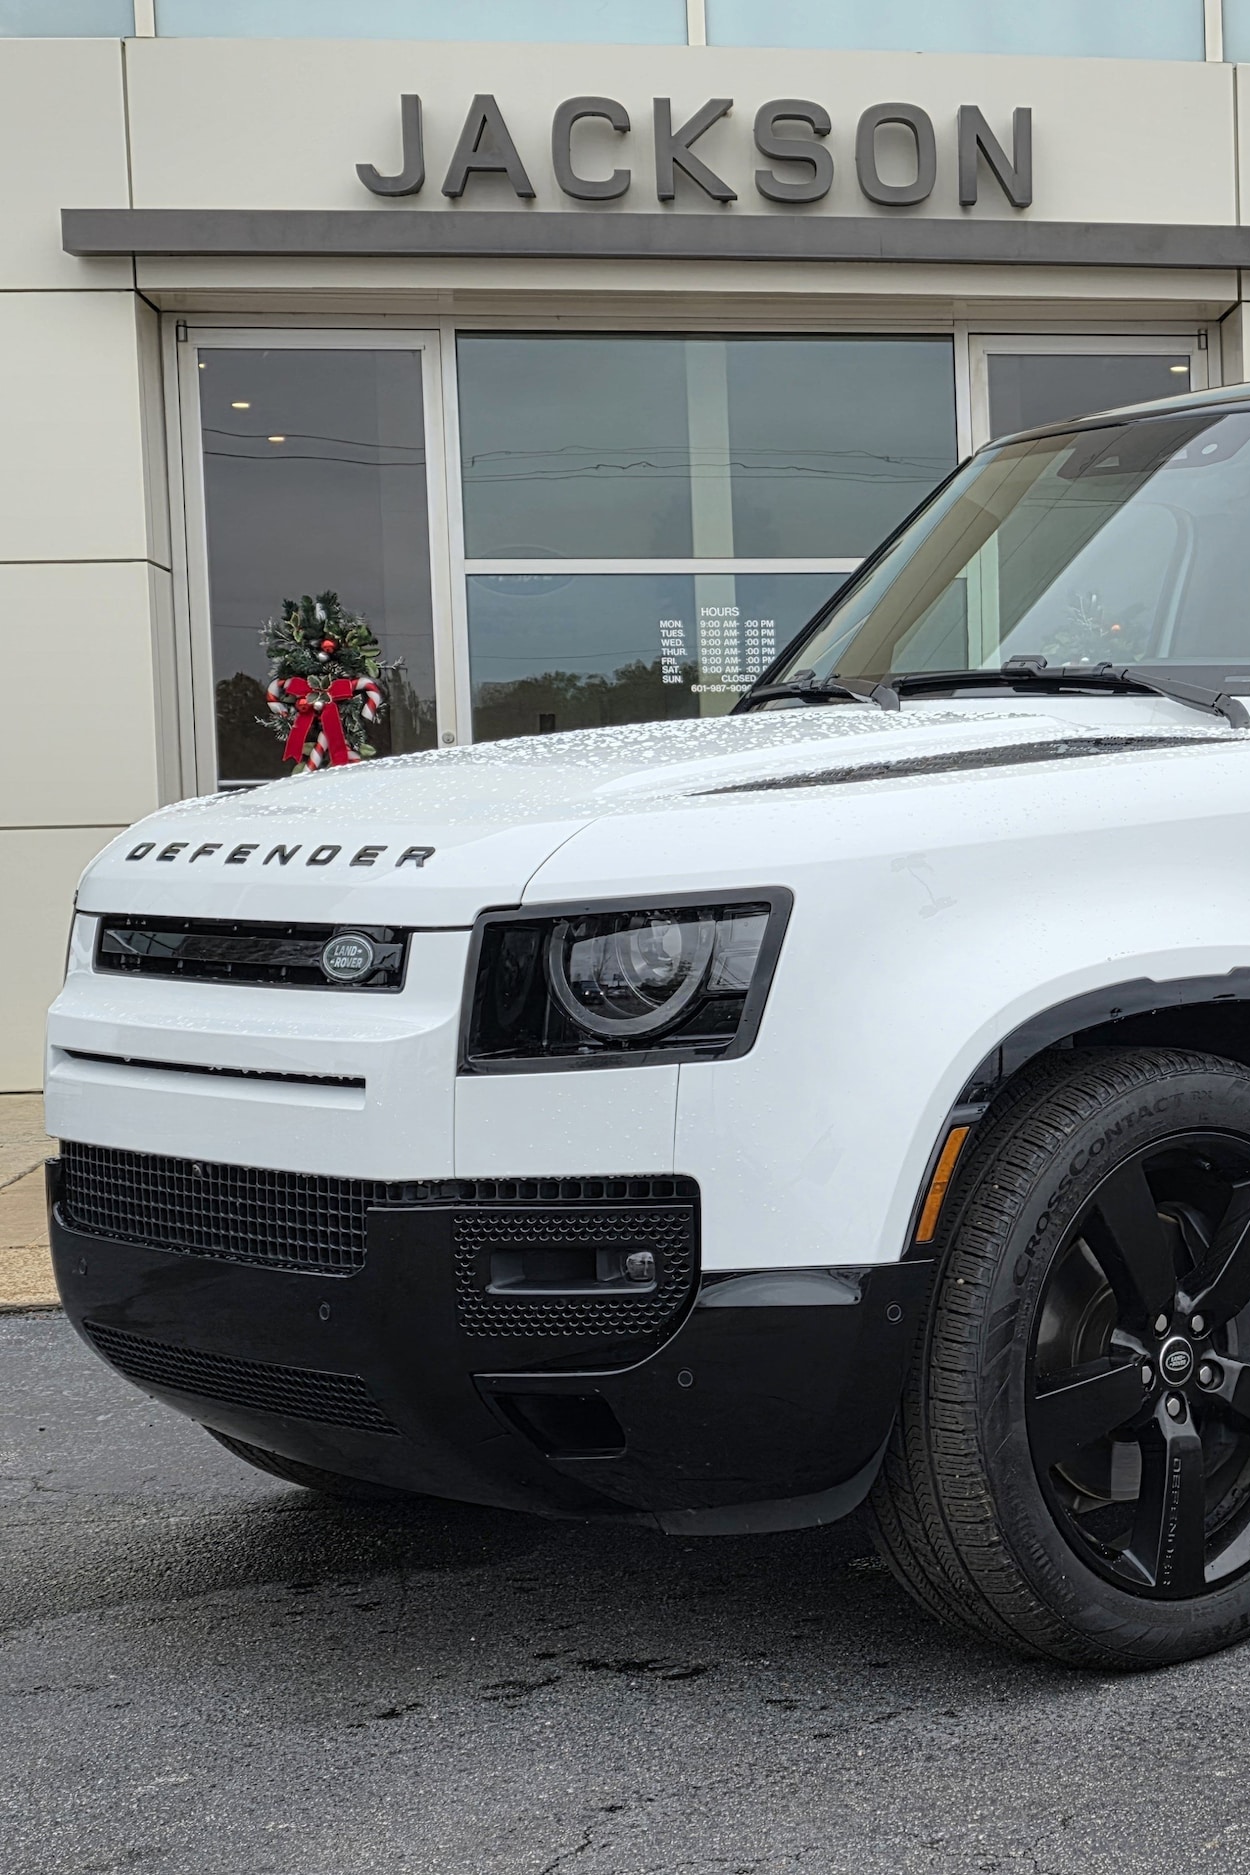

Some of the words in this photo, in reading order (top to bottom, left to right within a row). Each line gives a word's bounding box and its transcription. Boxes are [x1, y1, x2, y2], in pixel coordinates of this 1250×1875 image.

[356, 94, 1032, 208] JACKSON
[701, 607, 740, 617] HOURS
[660, 620, 683, 628] MON.
[700, 620, 720, 628] 9:00
[761, 620, 774, 628] PM
[660, 629, 685, 638] TUES.
[700, 629, 721, 637] 9:00
[761, 629, 775, 637] PM
[661, 639, 684, 647] WED.
[701, 638, 721, 646] 9:00
[762, 638, 775, 646] PM
[661, 648, 688, 656] THUR.
[701, 647, 722, 656] 9:00
[762, 647, 775, 655] PM
[661, 657, 678, 665] FRI.
[702, 656, 722, 665] 9:00
[762, 656, 775, 664] PM
[662, 665, 682, 674] SAT.
[702, 665, 723, 673] 9:00
[662, 675, 684, 684] SUN.
[721, 674, 757, 683] CLOSED
[125, 842, 436, 868] DEFENDER
[334, 945, 358, 956] LAND
[333, 957, 364, 968] ROVER
